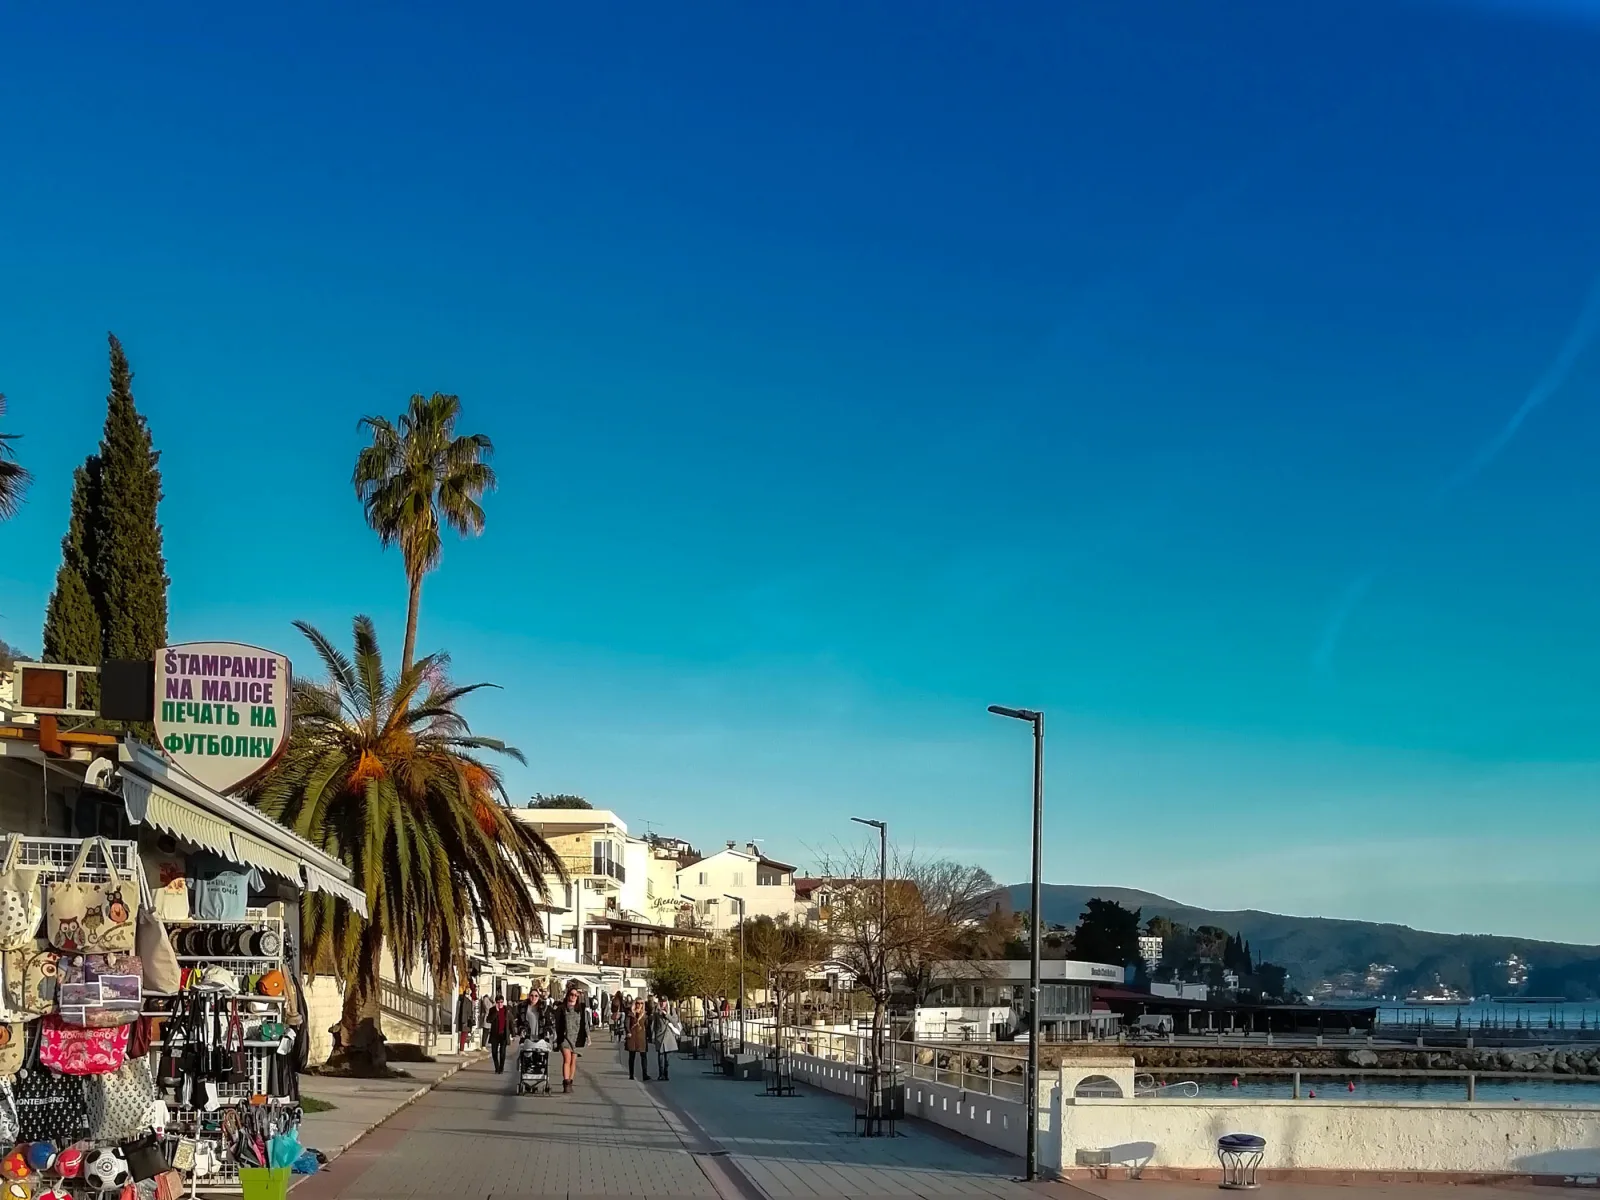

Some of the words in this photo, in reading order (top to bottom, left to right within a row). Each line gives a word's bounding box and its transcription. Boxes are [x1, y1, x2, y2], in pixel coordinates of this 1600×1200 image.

[165, 649, 277, 679] ŠTAMPANJE
[166, 678, 193, 700] NA
[202, 680, 273, 704] MAJICE
[162, 701, 240, 726] ПЕЧАТЬ
[251, 706, 277, 728] НА
[163, 732, 275, 758] ФУТБОЛКУ
